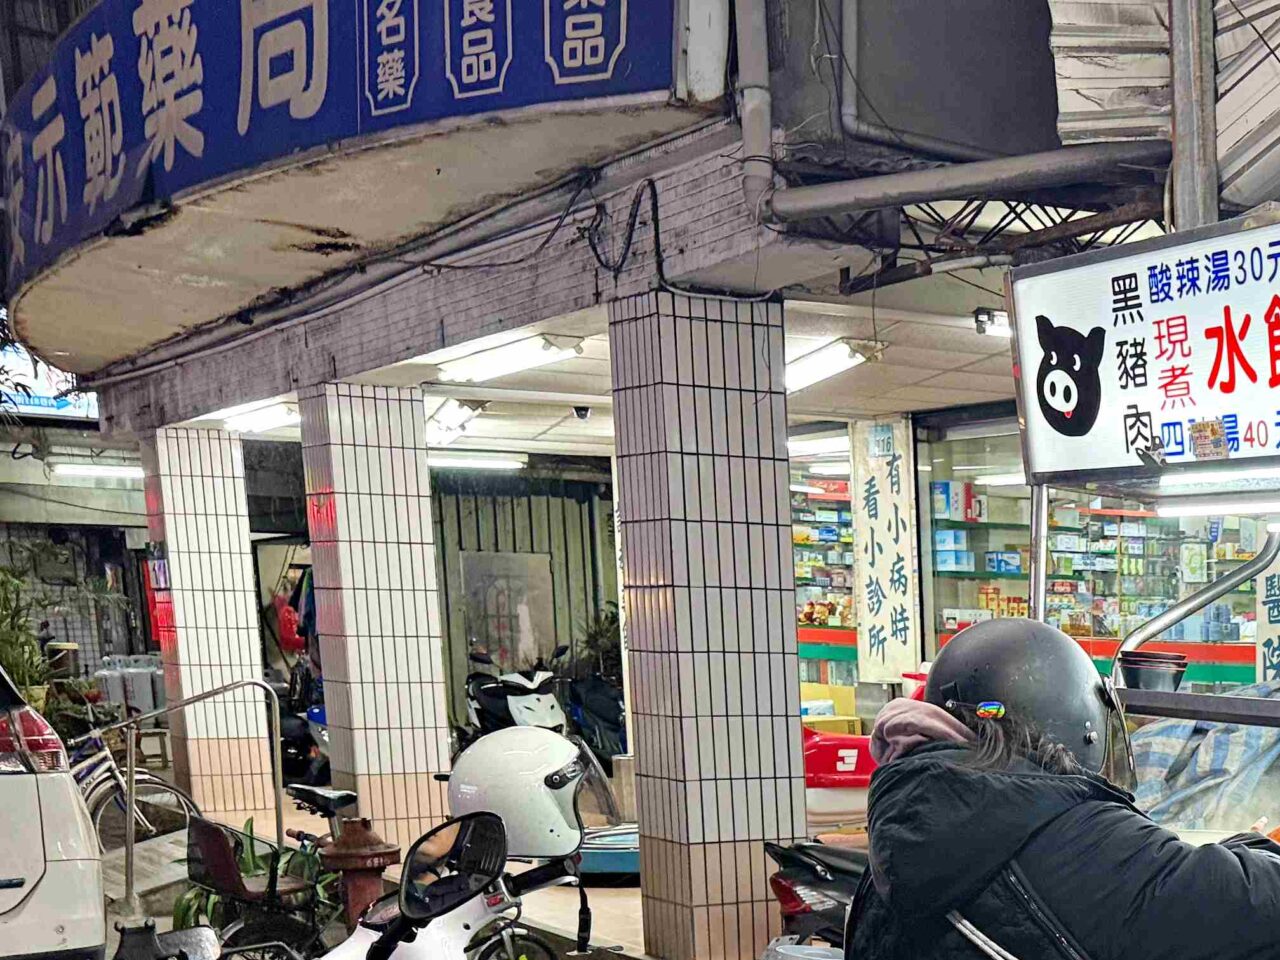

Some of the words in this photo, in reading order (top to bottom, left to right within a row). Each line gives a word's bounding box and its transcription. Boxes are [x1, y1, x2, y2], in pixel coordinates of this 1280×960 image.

[1110, 272, 1155, 456] 黑豬肉
[1152, 313, 1197, 411] 現煮
[862, 475, 888, 666] 看小診所
[885, 451, 911, 647] 有小病時
